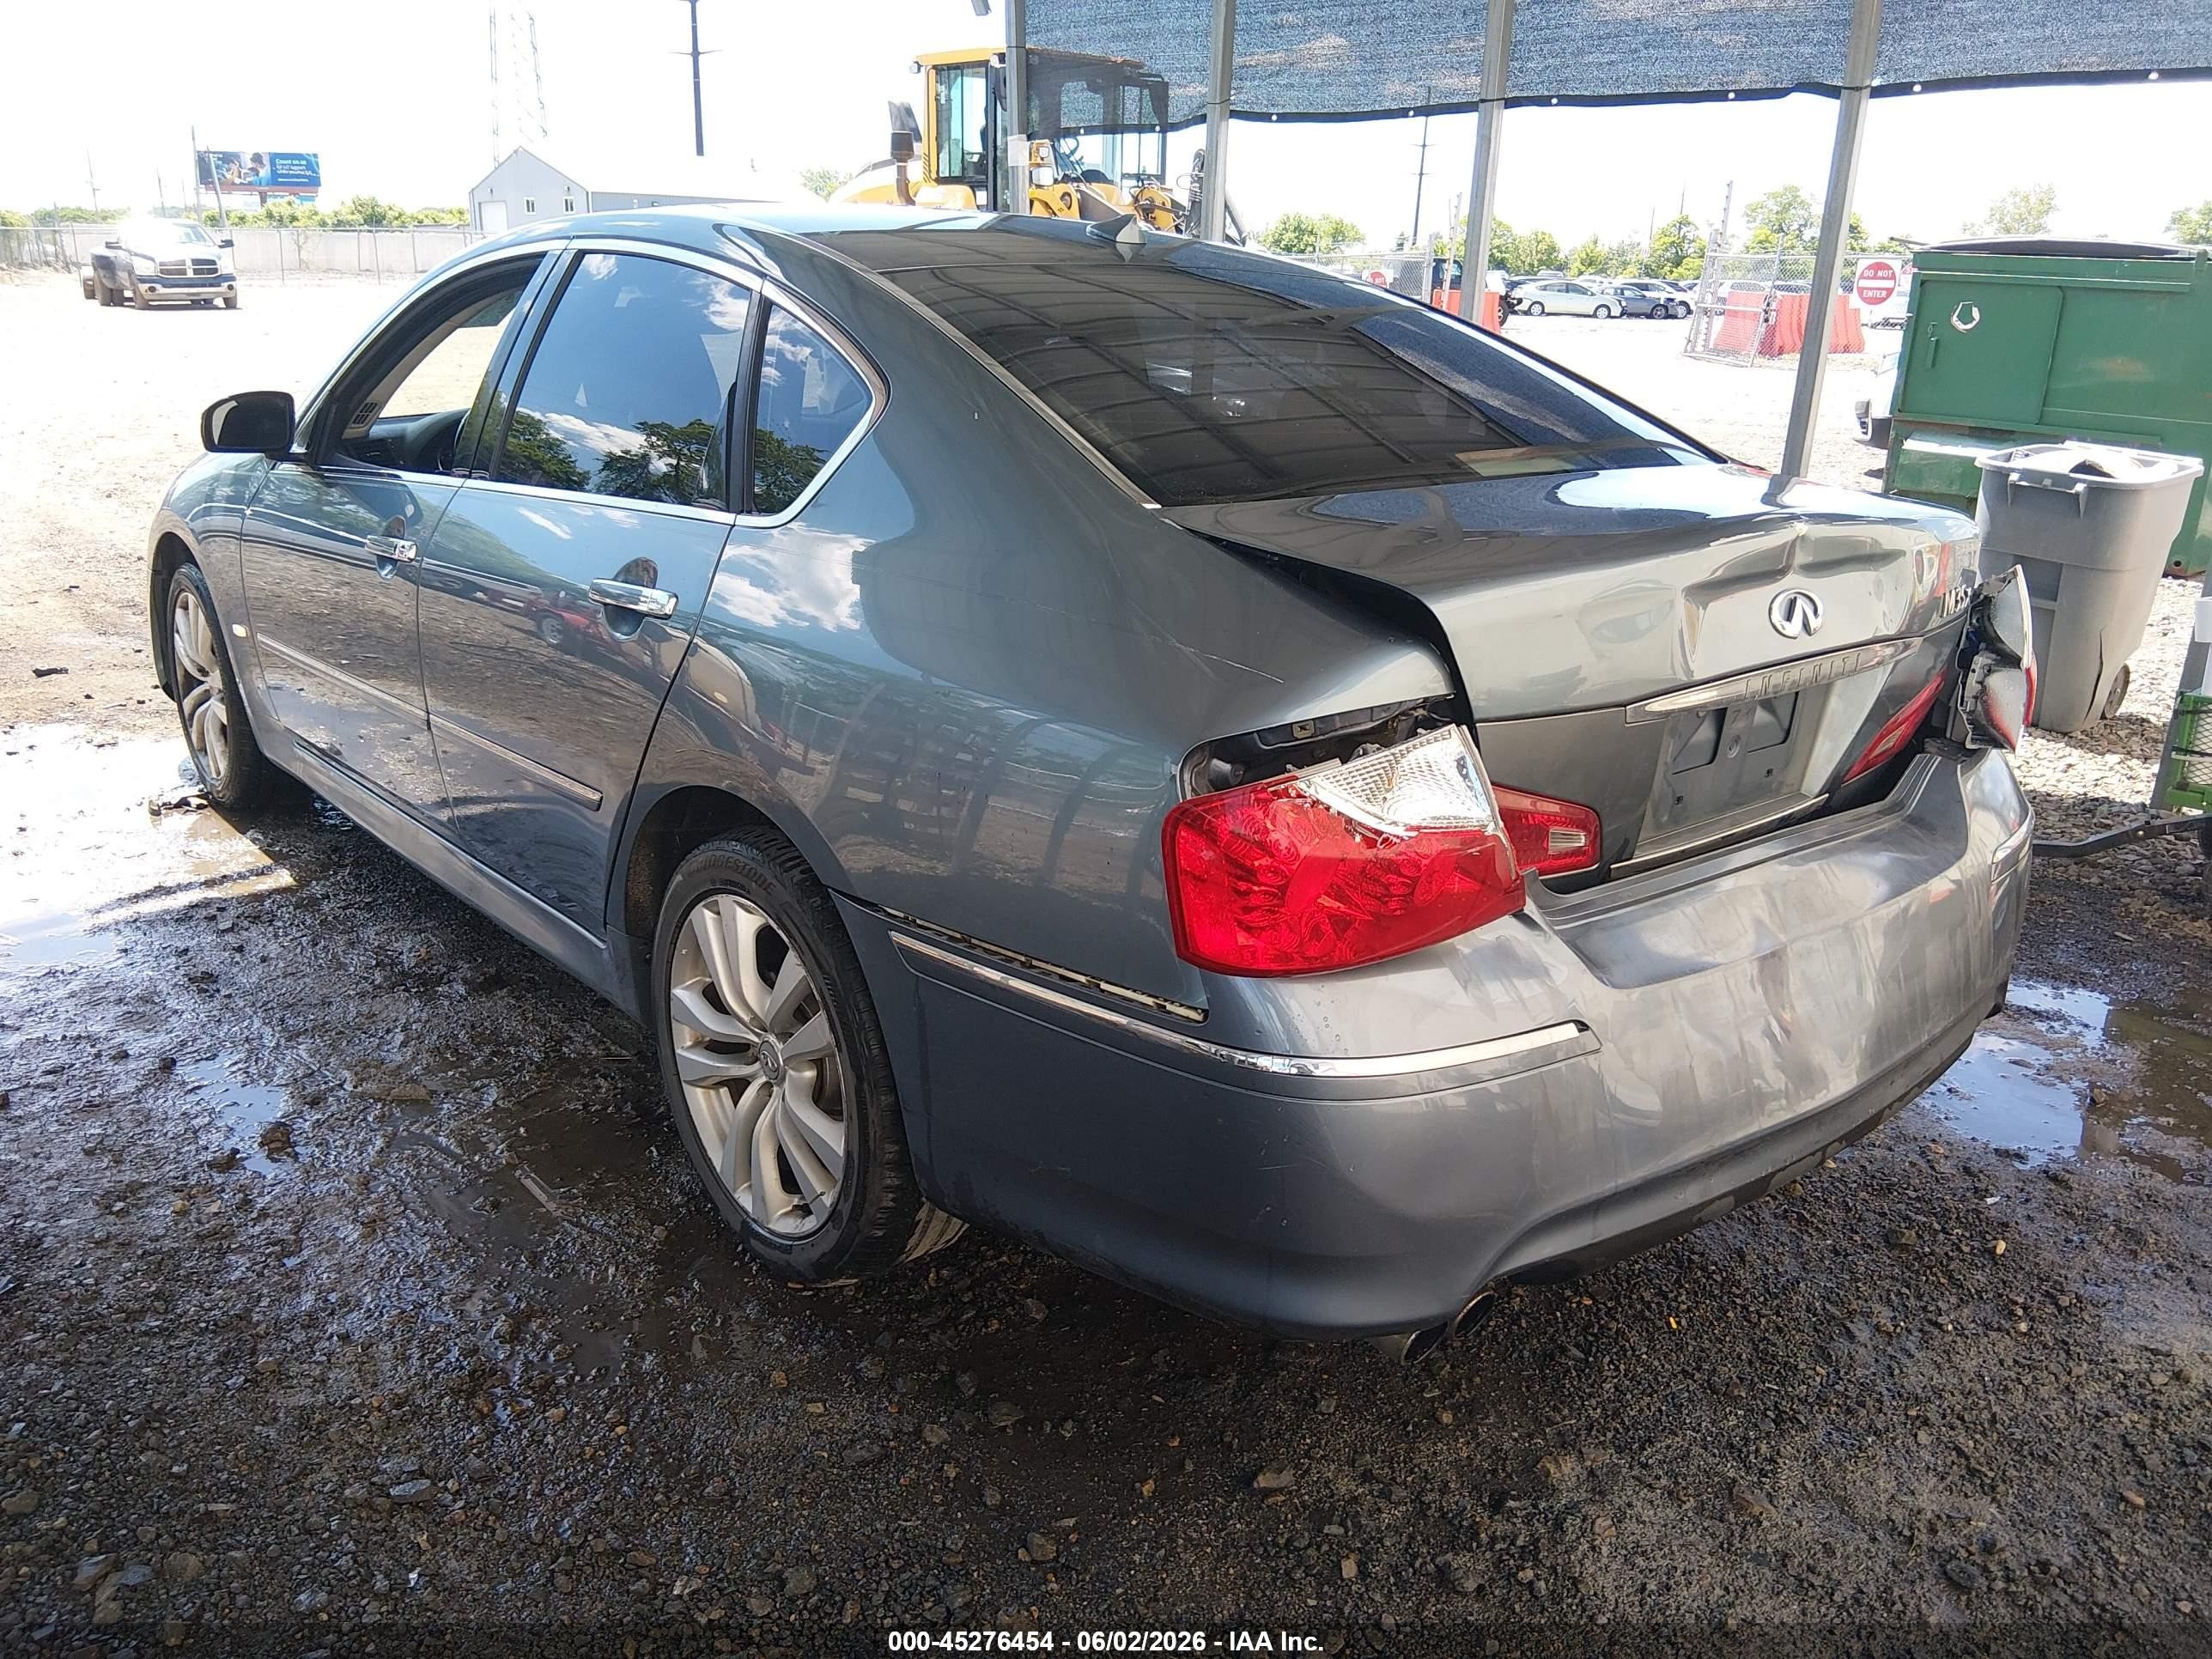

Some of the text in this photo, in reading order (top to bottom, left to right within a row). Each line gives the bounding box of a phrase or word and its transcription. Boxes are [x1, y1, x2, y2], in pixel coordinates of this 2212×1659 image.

[1877, 269, 1893, 277] NOT
[1863, 289, 1887, 298] ENTER
[1743, 653, 1862, 700] INFINITI
